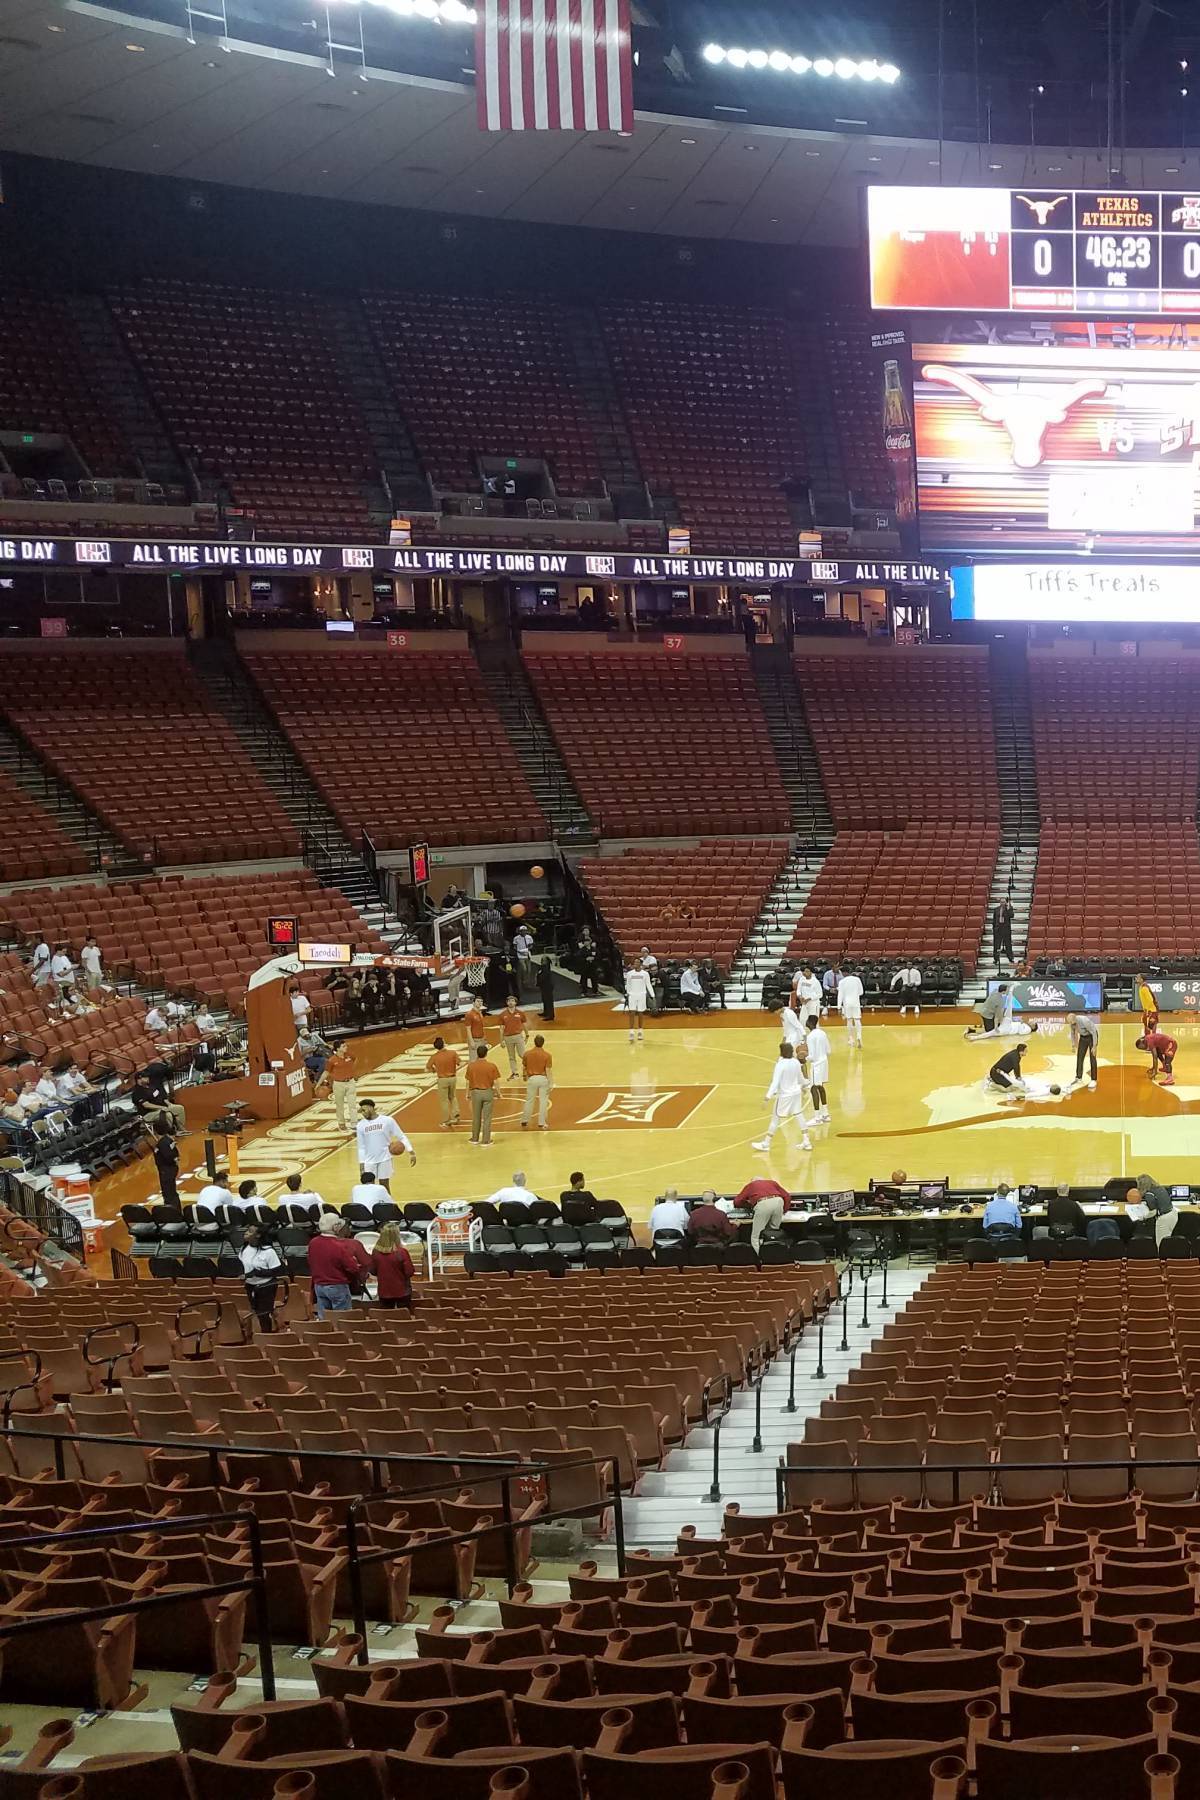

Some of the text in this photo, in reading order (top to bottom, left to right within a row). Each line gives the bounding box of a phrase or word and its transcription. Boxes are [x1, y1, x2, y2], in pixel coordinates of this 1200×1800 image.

[1097, 197, 1139, 212] TEXAS
[1082, 213, 1153, 227] ATHLETICS
[1034, 239, 1052, 276] 0
[1085, 236, 1151, 268] 46:23
[1183, 241, 1200, 279] 0
[1107, 271, 1128, 287] PRE
[1097, 417, 1135, 453] VS
[21, 541, 54, 560] DAY
[133, 544, 323, 566] ALL THE LIVE LONG DAY
[394, 551, 568, 572] ALL THE LIVE LONG DAY
[633, 558, 795, 578] ALL THE LIVE LONG DAY
[855, 564, 880, 580] ALL
[883, 564, 907, 580] THE
[911, 565, 940, 581] LIVE
[1024, 571, 1160, 593] Tiff's Treats
[390, 635, 406, 646] 38
[665, 637, 682, 648] 37
[899, 631, 911, 641] 36
[1121, 643, 1136, 654] 35
[272, 921, 293, 930] 46:22
[308, 946, 341, 959] Tacodeli
[1183, 996, 1196, 1005] 30
[286, 1066, 307, 1087] MUSCLE
[290, 1080, 304, 1097] MILK
[450, 1222, 460, 1232] G
